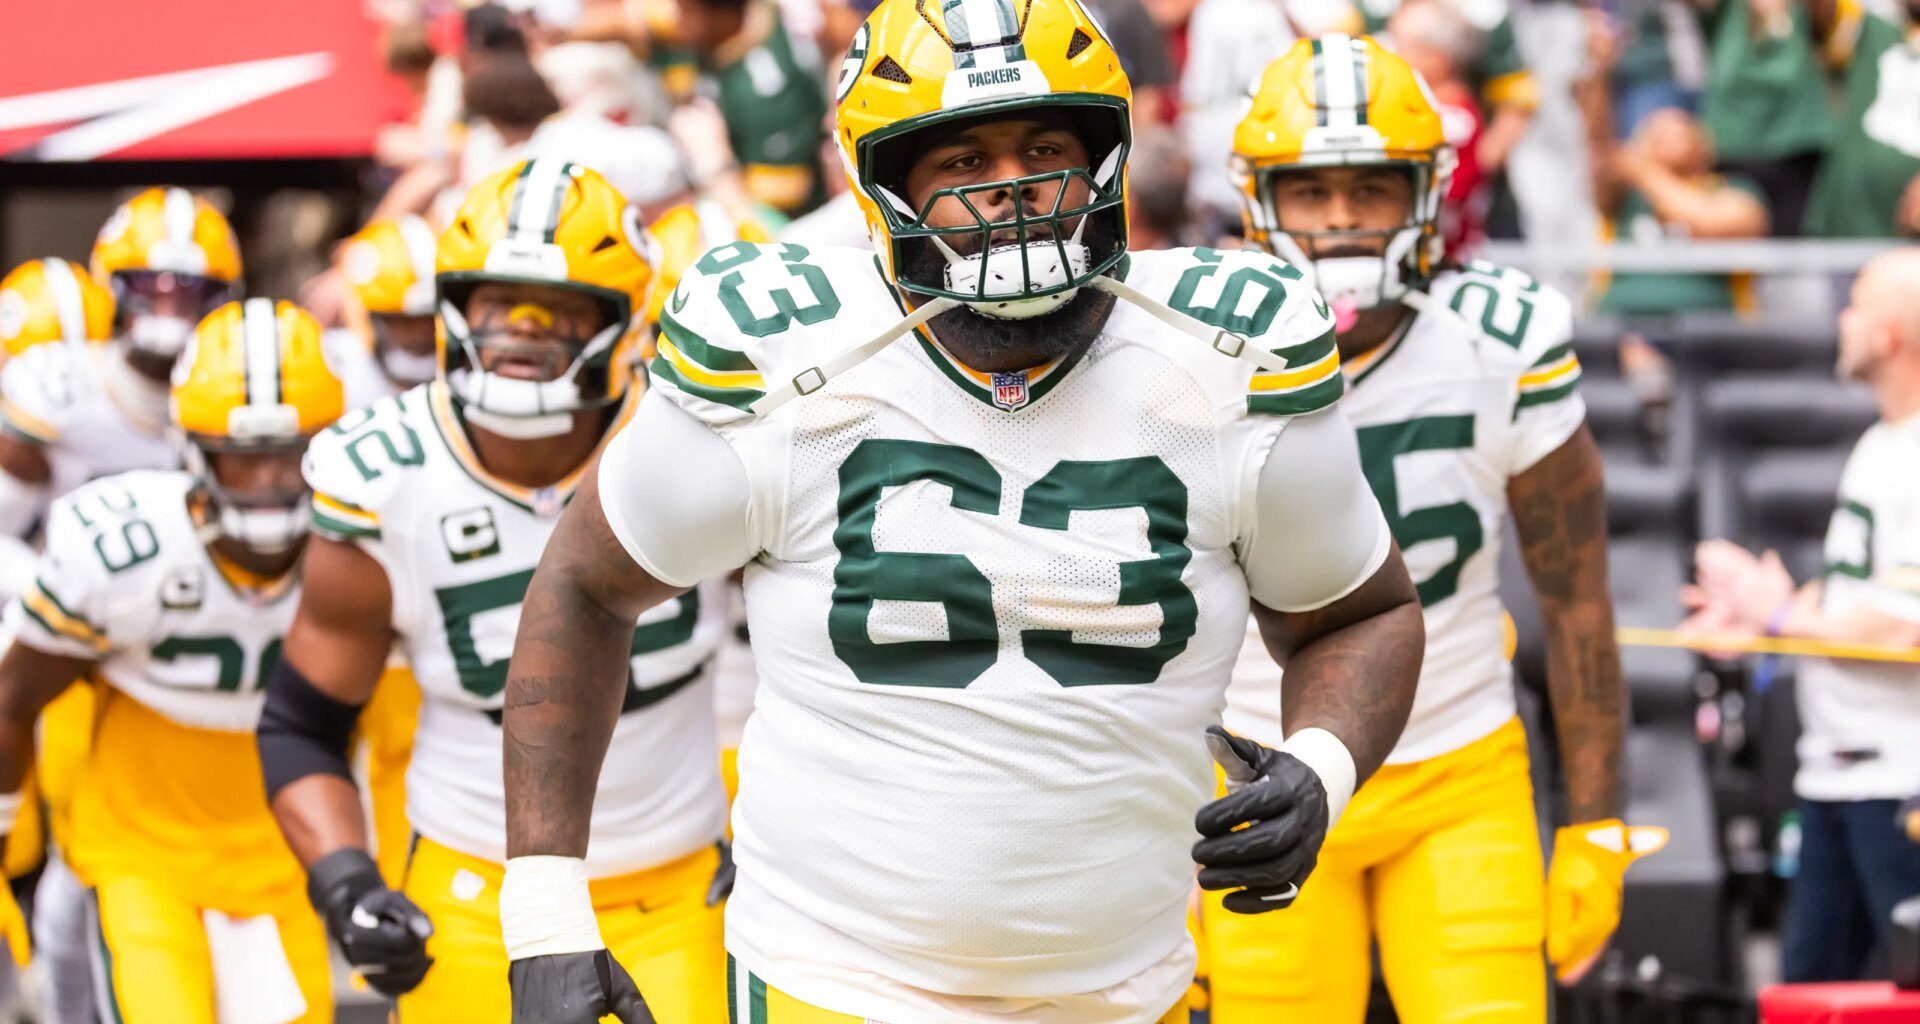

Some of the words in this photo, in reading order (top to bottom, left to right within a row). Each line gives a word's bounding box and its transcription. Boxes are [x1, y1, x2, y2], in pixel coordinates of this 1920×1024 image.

[967, 67, 1021, 88] PACKERS
[695, 241, 842, 338] 63
[1167, 246, 1304, 338] 6
[998, 385, 1024, 403] NFL
[828, 438, 1198, 689] 63
